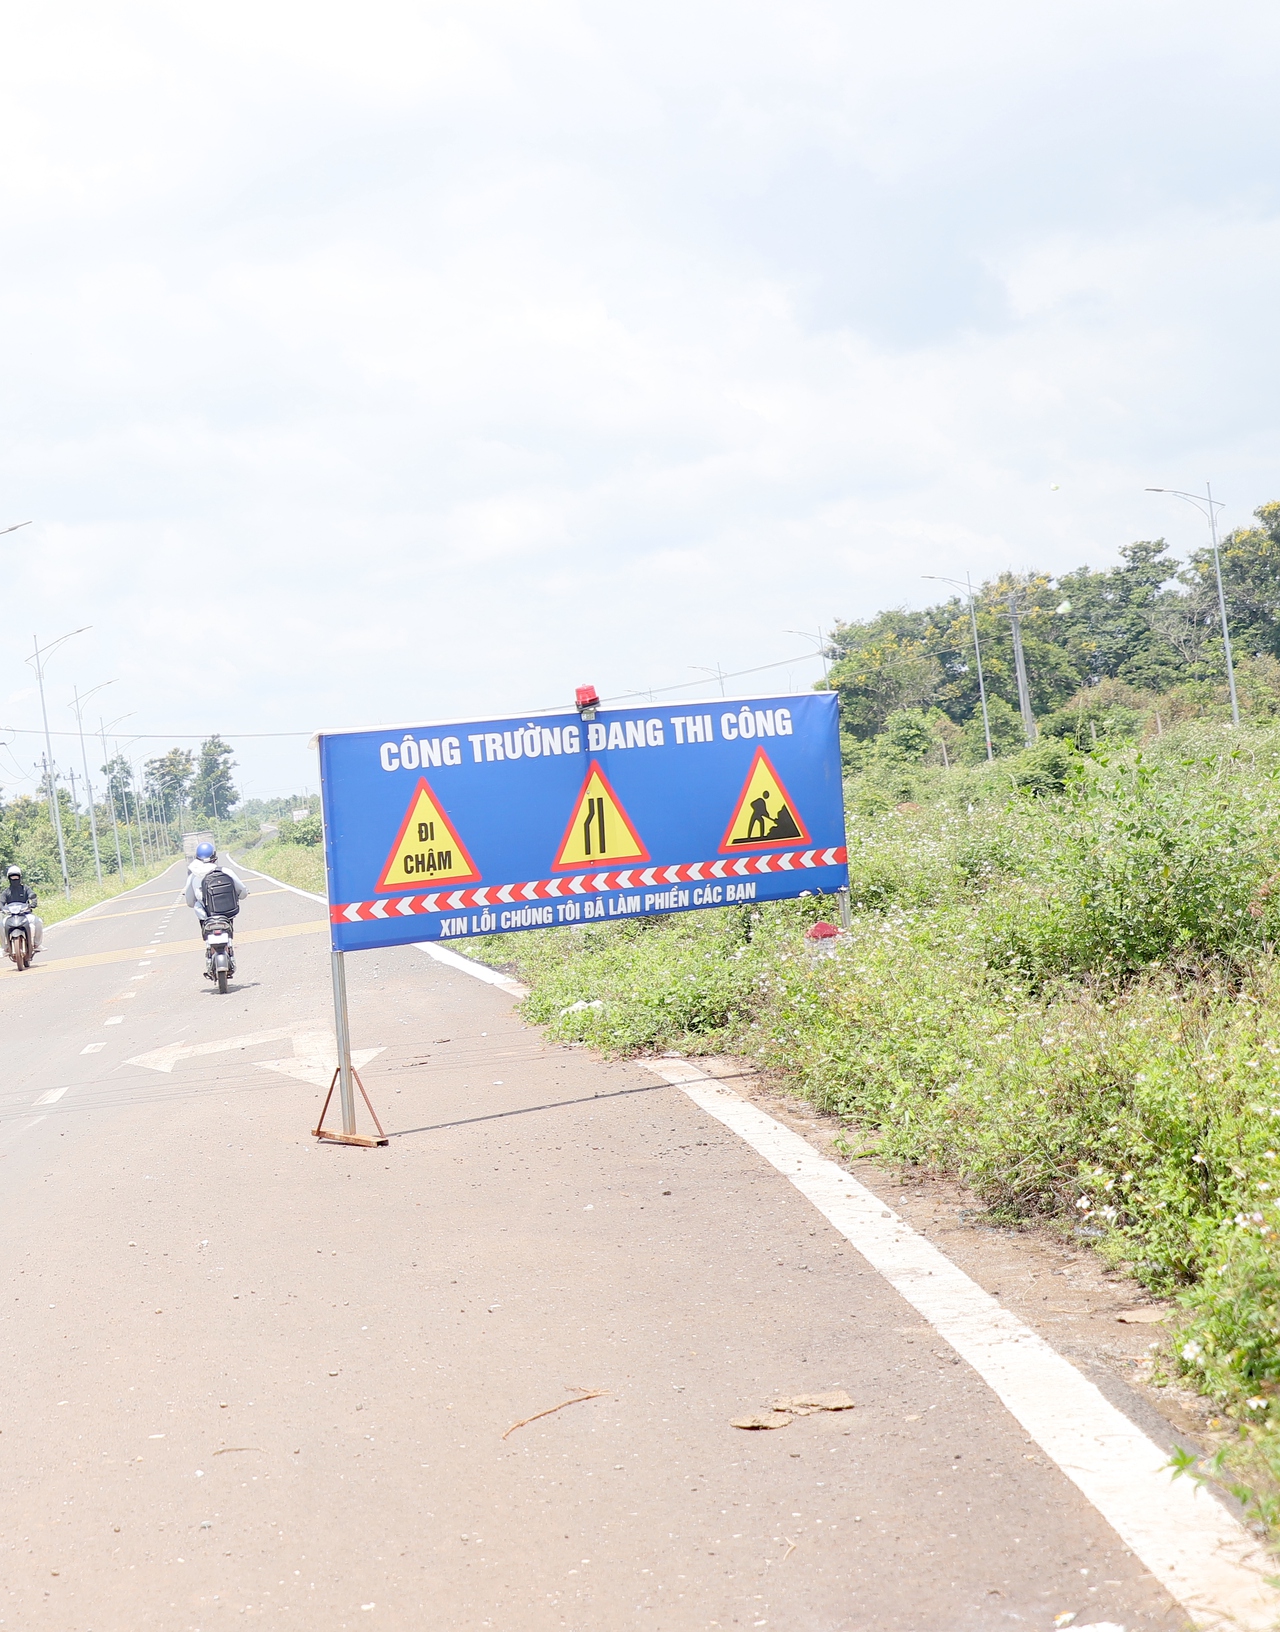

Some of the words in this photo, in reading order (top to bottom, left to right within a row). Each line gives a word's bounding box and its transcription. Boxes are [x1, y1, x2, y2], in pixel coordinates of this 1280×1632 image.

[379, 734, 462, 772] CÔNG
[468, 722, 580, 763] TRƯỜNG
[587, 718, 664, 752] ĐANG
[670, 714, 714, 744] THI
[720, 705, 793, 741] CÔNG
[417, 821, 435, 842] ĐI
[403, 848, 452, 876] CHẬM
[440, 916, 468, 938] XIN
[472, 907, 496, 933] LỖI
[501, 905, 553, 929] CHÚNG
[556, 899, 581, 922] TÔI
[584, 896, 605, 919] ĐÃ
[608, 893, 641, 916] LÀM
[644, 885, 689, 911] PHIỀN
[693, 883, 722, 906] CÁC
[726, 882, 757, 903] BẠN
